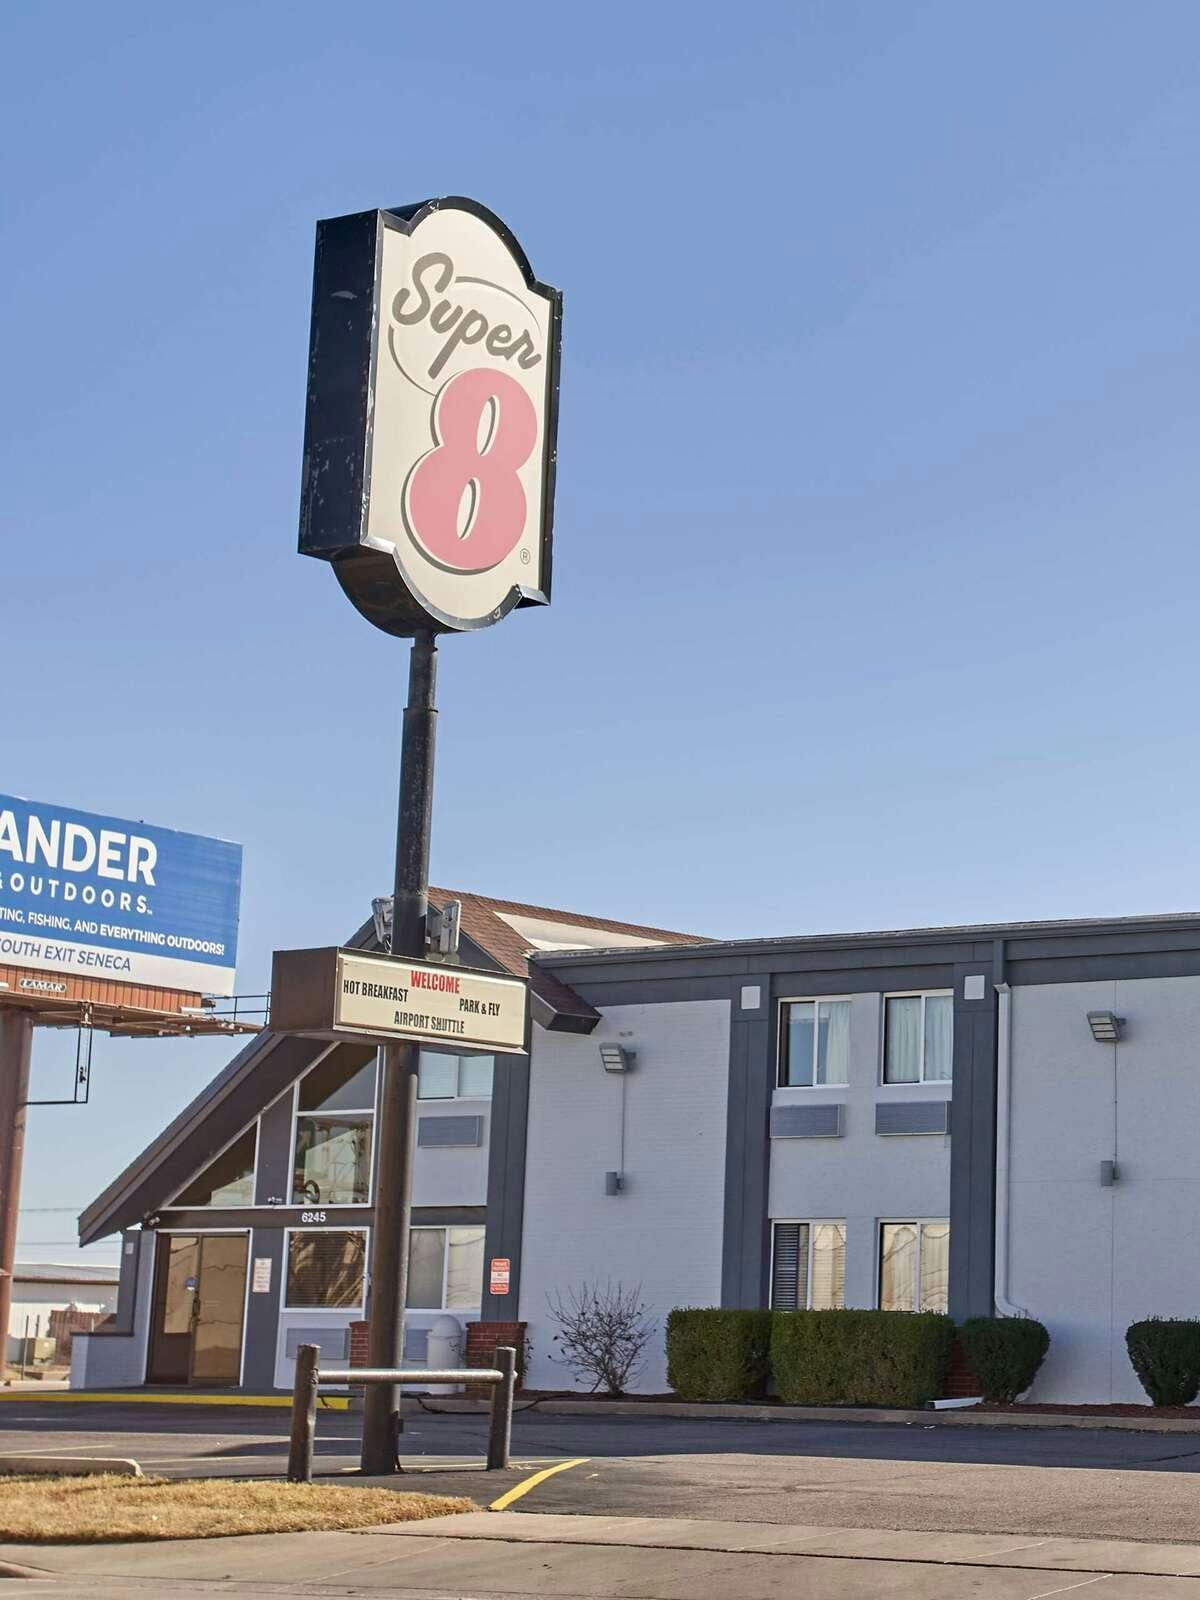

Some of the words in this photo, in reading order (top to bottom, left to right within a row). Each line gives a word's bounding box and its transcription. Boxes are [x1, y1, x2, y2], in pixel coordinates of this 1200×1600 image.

[391, 252, 541, 380] Super
[401, 367, 538, 575] 8
[0, 810, 158, 887] ANDER
[28, 912, 72, 931] FISHING,
[74, 919, 98, 934] AND
[100, 923, 165, 945] EVERYTHING
[167, 935, 225, 956] OUTDOORS!
[0, 938, 41, 957] OUTH
[44, 945, 76, 961] EXIT
[78, 950, 131, 971] SENECA
[343, 979, 361, 995] HOT
[362, 982, 409, 1002] BREAKFAST
[411, 970, 460, 993] WELCOME
[459, 998, 480, 1014] PARK
[481, 1003, 487, 1015] &
[488, 1002, 501, 1016] FLY
[394, 1010, 430, 1029] AIRPORT
[431, 1016, 464, 1033] SHUTTLE
[301, 1211, 327, 1223] 6245
